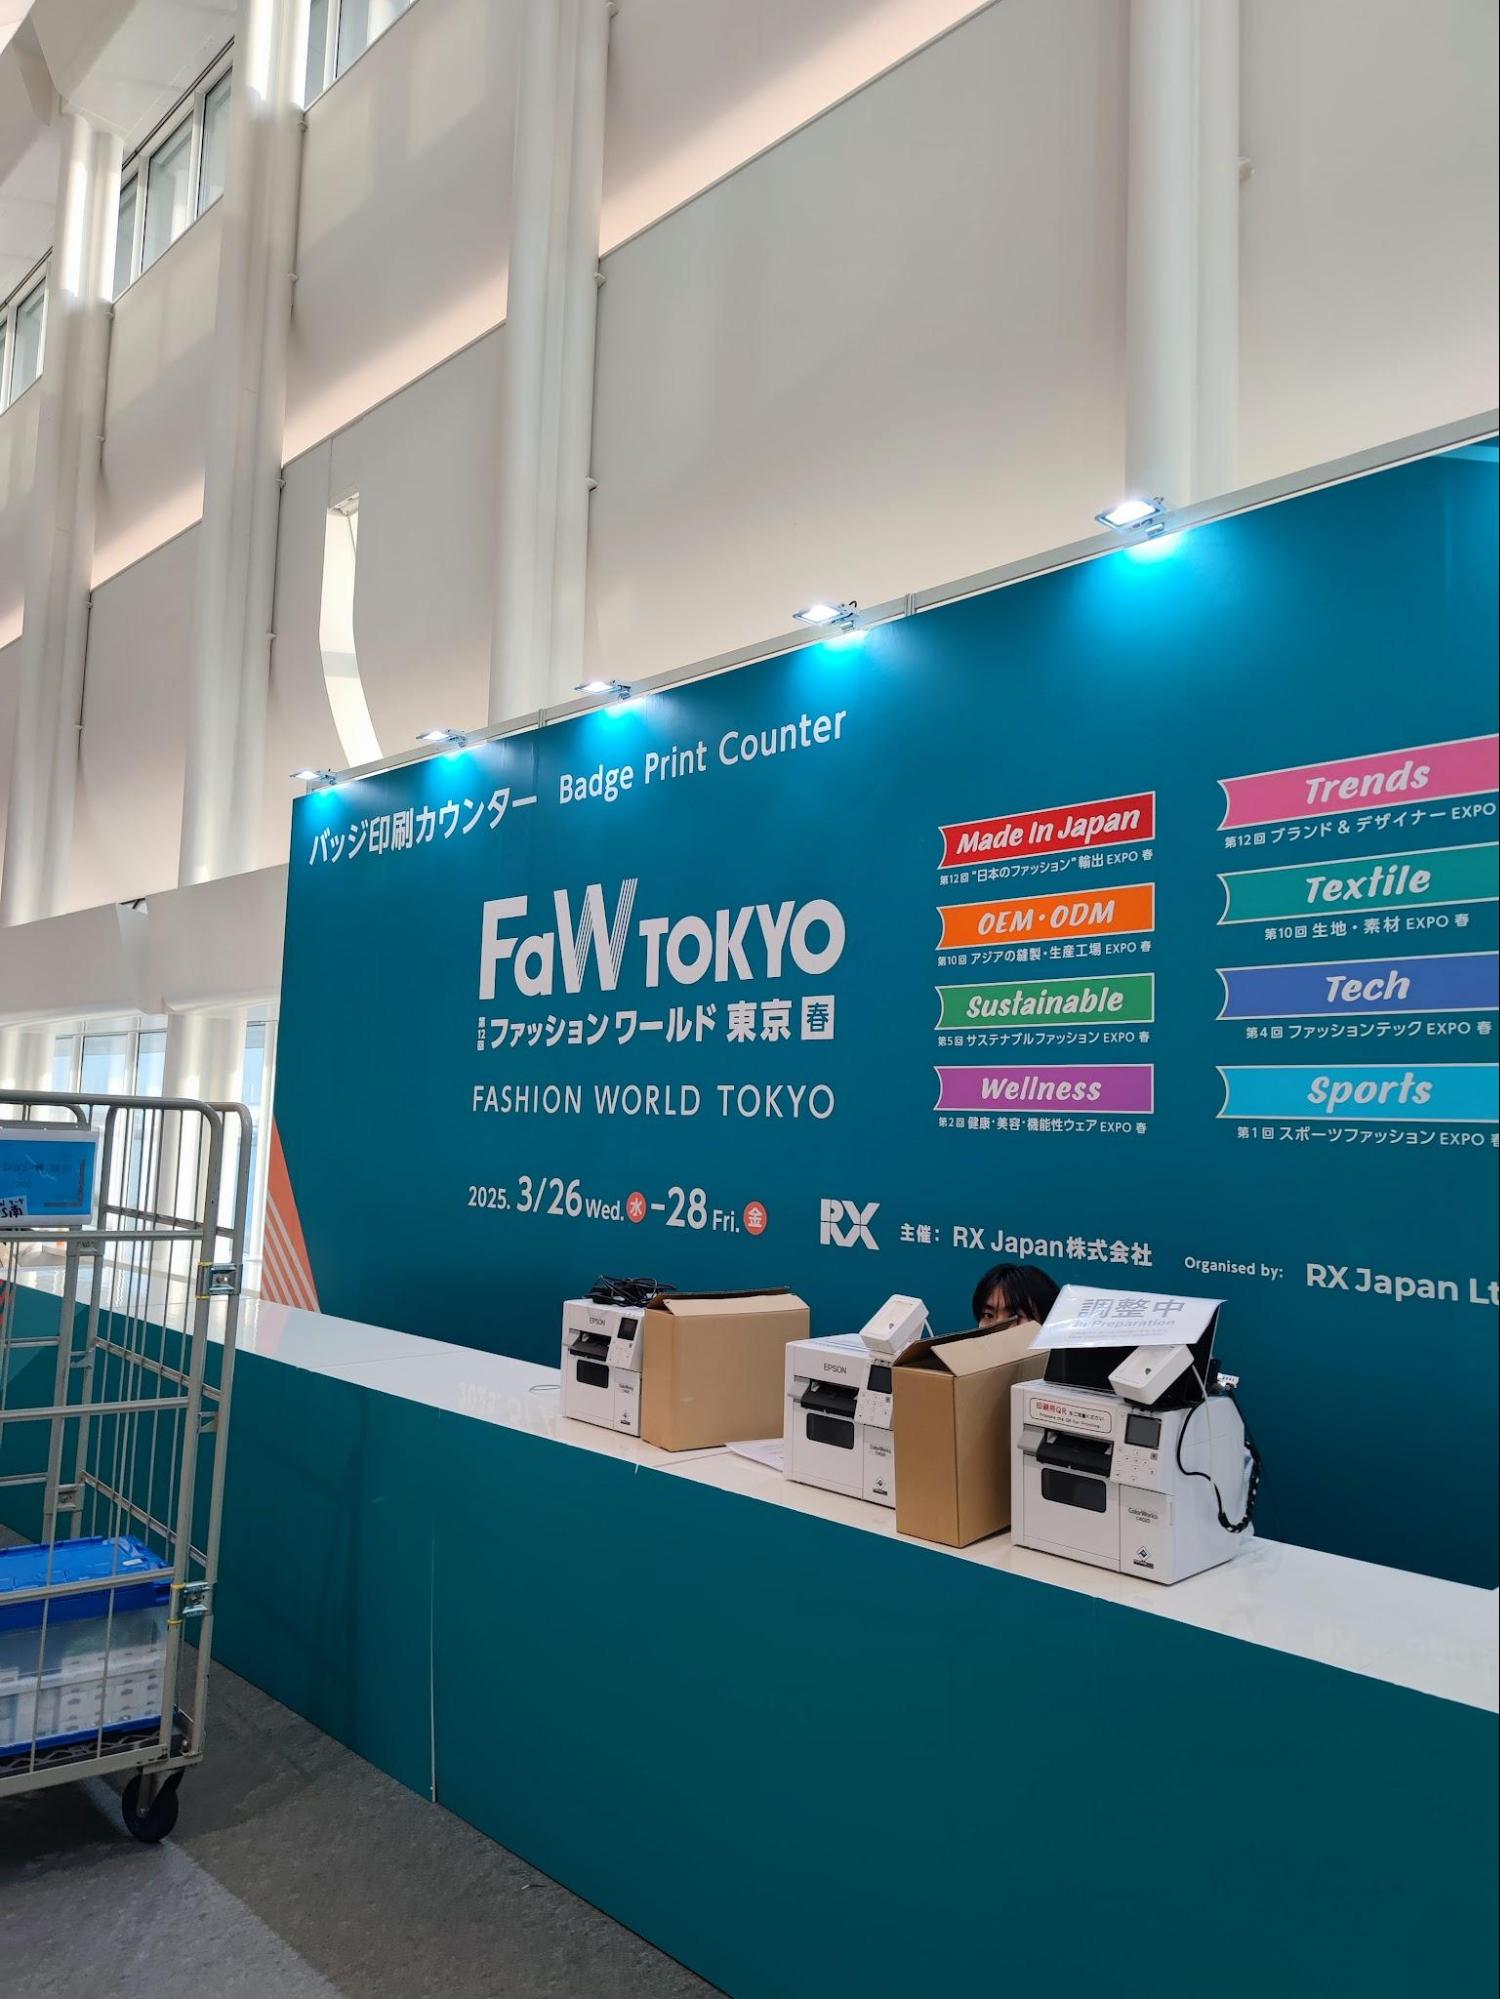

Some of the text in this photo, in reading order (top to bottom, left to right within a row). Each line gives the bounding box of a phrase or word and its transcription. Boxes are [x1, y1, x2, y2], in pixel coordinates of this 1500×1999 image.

[559, 710, 848, 804] Badge Print Counter
[1305, 760, 1431, 805] Trends
[308, 788, 537, 866] バッジ印刷カウンター
[956, 808, 1141, 855] Made In Japan
[1224, 802, 1497, 849] 第12回 ブランド & デザイナー EXPO
[1106, 851, 1138, 865] EXPO
[1141, 848, 1153, 861] 春
[1305, 864, 1431, 904] Textile
[479, 877, 846, 1000] FaW TOKYO
[1264, 926, 1308, 941] 第10回
[1406, 915, 1449, 930] EXPO
[1454, 912, 1470, 927] 春
[1105, 942, 1137, 955] EXPO
[1140, 941, 1152, 953] 春
[966, 987, 1124, 1019] Sustainable
[1326, 970, 1411, 1003] Tech
[727, 998, 793, 1042] 東京
[803, 999, 832, 1036] 春
[1246, 1021, 1492, 1039] 第4回 ファッションテック EXPO 春
[966, 1031, 1100, 1047] サステナブルファッション
[1103, 1031, 1135, 1044] EXPO
[1138, 1031, 1150, 1043] 春
[472, 1084, 835, 1120] FASHION WORLD TOKYO
[981, 1075, 1102, 1101] Wellness
[1306, 1071, 1434, 1114] Sports
[1100, 1121, 1132, 1133] EXPO
[1135, 1122, 1147, 1134] 春
[1237, 1126, 1275, 1140] 第1回
[1279, 1126, 1436, 1145] スポーツファッション
[1440, 1132, 1485, 1146] EXPO
[468, 1185, 511, 1210] 2025.
[516, 1174, 583, 1217] 3/26
[586, 1197, 625, 1222] Wed.
[628, 1194, 645, 1220] 水
[712, 1209, 740, 1233] Fri.
[745, 1204, 765, 1231] 金
[820, 1198, 880, 1251] RX
[953, 1225, 985, 1250] RX
[1184, 1256, 1255, 1275] Organised
[1261, 1263, 1284, 1281] by:
[1306, 1263, 1349, 1290] RX
[1354, 1267, 1459, 1303] Japan
[1079, 1298, 1186, 1318] 調整中
[823, 1363, 847, 1375] EPSON
